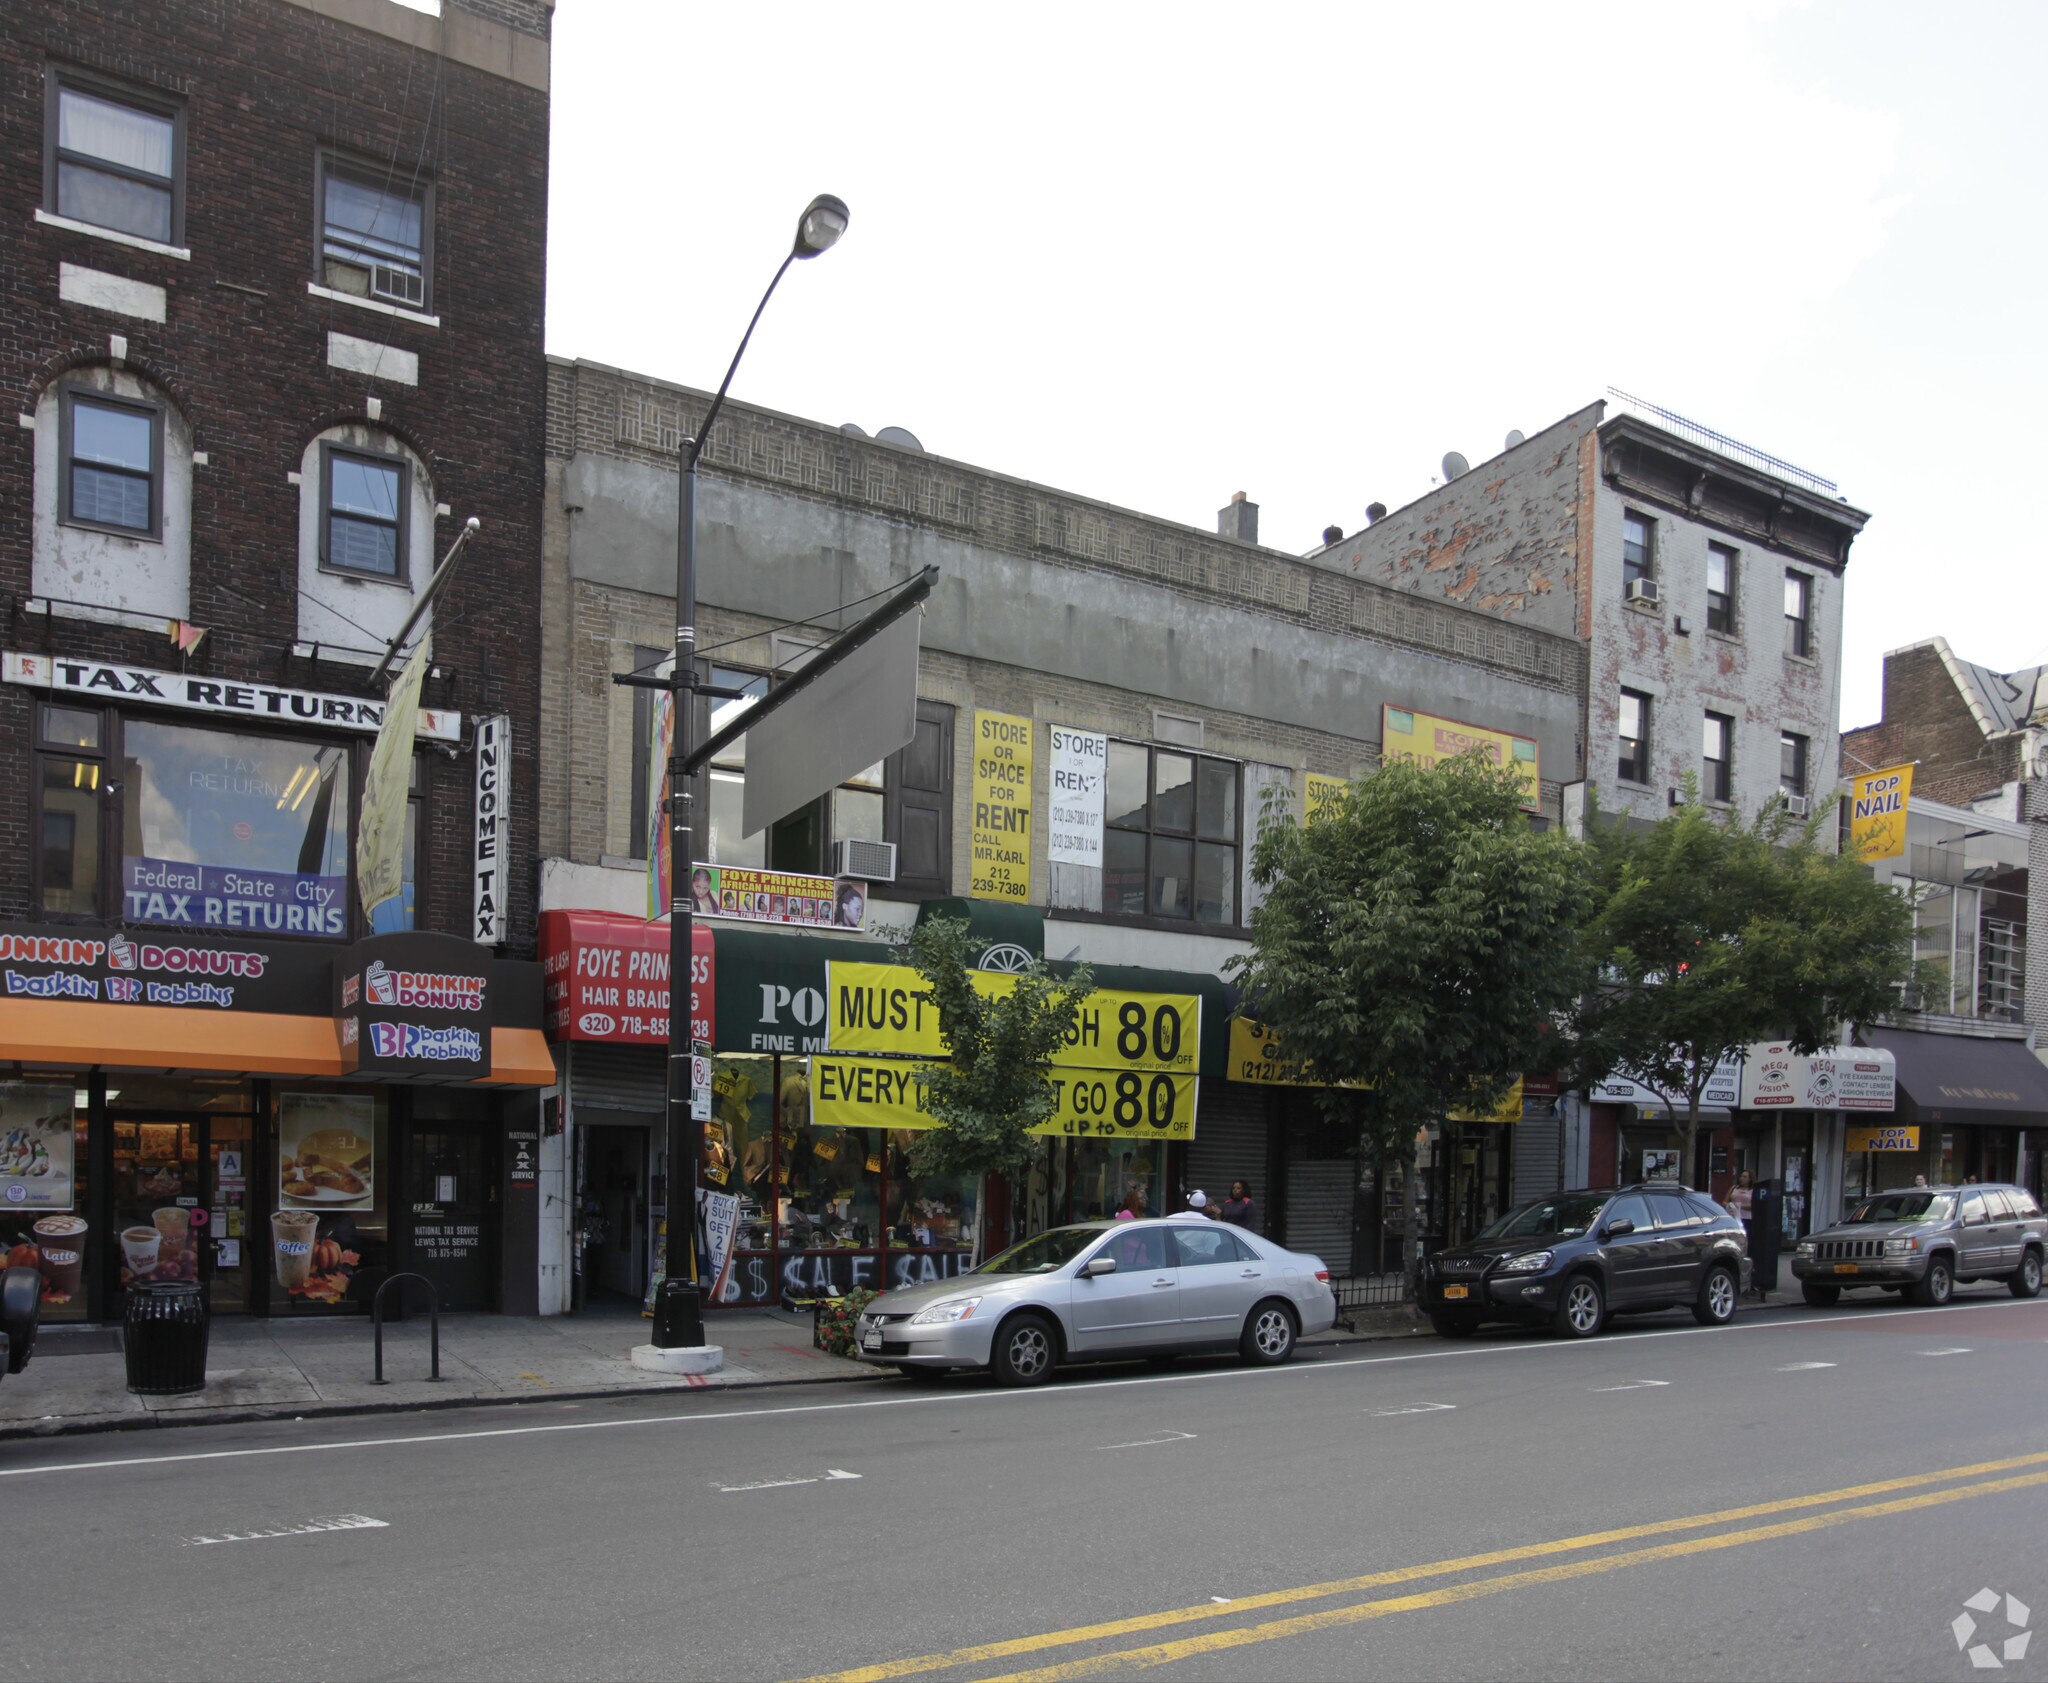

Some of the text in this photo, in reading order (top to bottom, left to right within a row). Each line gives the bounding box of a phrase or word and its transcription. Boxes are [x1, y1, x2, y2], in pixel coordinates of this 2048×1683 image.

[57, 662, 385, 727] TAX RETURN
[982, 718, 1028, 745] STORE
[994, 746, 1013, 760] OR
[1053, 731, 1104, 758] STORE
[223, 756, 263, 774] TAX
[979, 759, 1025, 784] SPACE
[990, 786, 1014, 801] FOR
[1864, 775, 1899, 795] TOP
[1854, 792, 1902, 819] NAIL
[975, 802, 1029, 834] RENT
[477, 724, 496, 938] INCOME TAX
[973, 833, 1001, 846] CALL
[721, 869, 834, 891] FOYE PRINCESS
[990, 867, 1010, 880] 212
[133, 864, 335, 907] Federal State City
[720, 880, 833, 900] AFRICAN HAIR BRAIDING
[972, 878, 1026, 896] 239-7380
[126, 889, 344, 935] TAX RETURNS
[0, 934, 264, 978] UNKIN' DONUTS
[555, 949, 570, 972] LASH
[576, 947, 710, 984] FOYE PRINSS
[5, 970, 99, 1000] baskin
[147, 982, 235, 1007] robbins
[400, 972, 486, 994] DUNKIN'
[400, 990, 483, 1011] DONUTS
[582, 986, 700, 1011] HAIR BRAIDG
[839, 985, 928, 1033] MUST
[584, 1016, 610, 1032] 320
[1117, 1001, 1181, 1062] 80
[1177, 1055, 1193, 1064] OFF
[419, 1025, 480, 1046] baskin
[751, 1033, 795, 1053] FINE
[420, 1045, 482, 1062] robbins
[1129, 1061, 1154, 1070] original
[1242, 1061, 1274, 1081] (212)
[1761, 1061, 1789, 1073] MEGA
[1810, 1060, 1836, 1076] MEGA
[1842, 1081, 1868, 1089] CONTACT
[1852, 1073, 1893, 1082] EXAMINATIONS
[1758, 1082, 1790, 1093] VISION
[1073, 1080, 1107, 1115] GO
[1113, 1072, 1176, 1129] 80
[1173, 1121, 1189, 1132] OFF
[1807, 1089, 1837, 1107] VISION
[508, 1131, 537, 1140] NATIONAL
[1125, 1130, 1168, 1138] original price
[1879, 1129, 1905, 1137] TOP
[1868, 1138, 1915, 1149] NAIL
[223, 1155, 237, 1169] A
[515, 1141, 530, 1170] TAX
[511, 1171, 534, 1179] SERVICE
[713, 1195, 730, 1207] BUY
[711, 1206, 733, 1221] SUIT
[414, 1225, 479, 1236] NATIONAL TAX SERVICE
[709, 1220, 731, 1236] GET
[414, 1238, 479, 1246] LEWIS TAX SERVICE
[715, 1236, 723, 1250] 2
[46, 1250, 78, 1261] Latte
[710, 1250, 727, 1263] UIT
